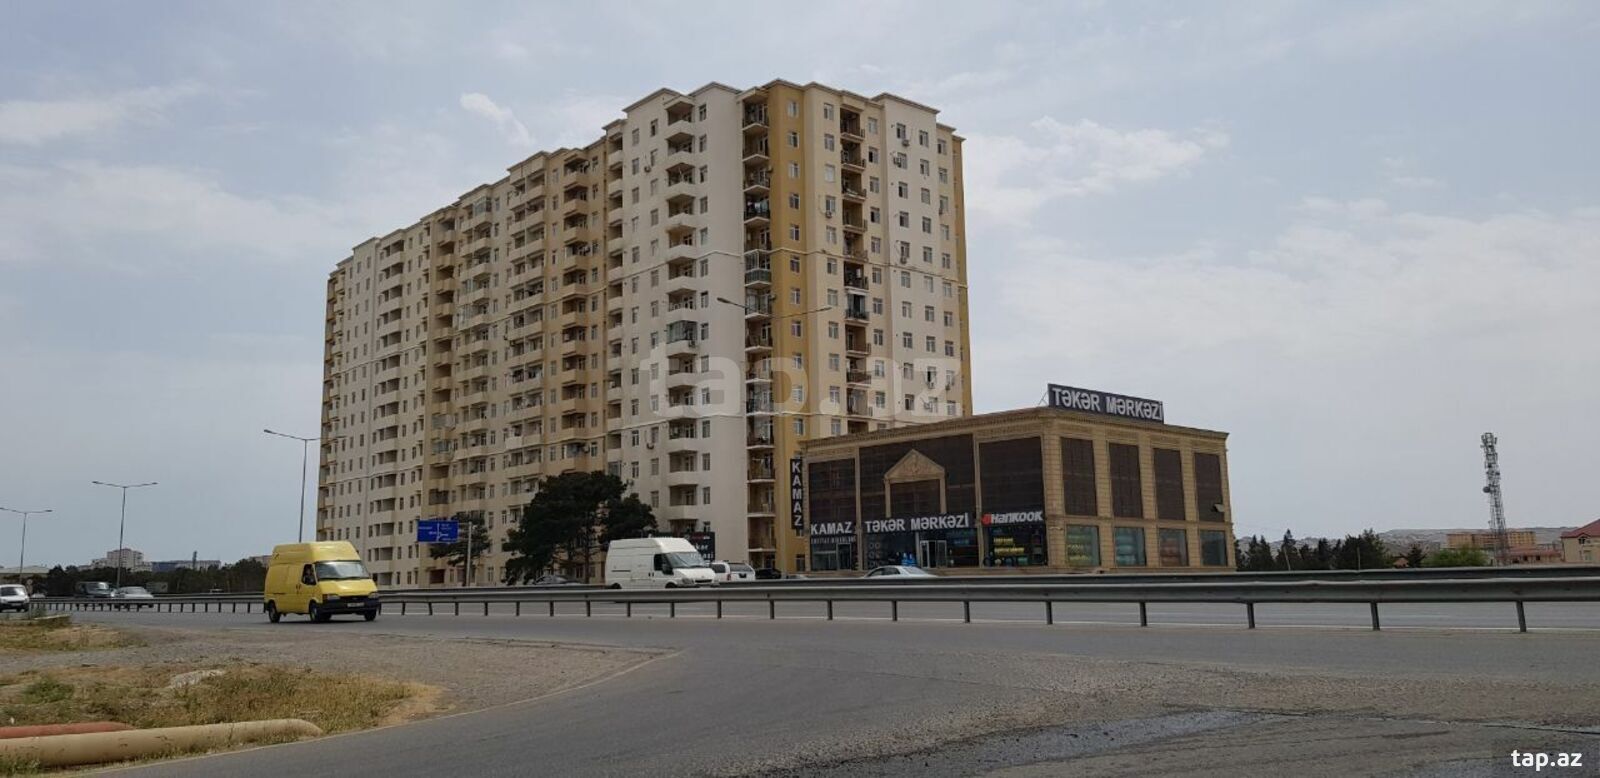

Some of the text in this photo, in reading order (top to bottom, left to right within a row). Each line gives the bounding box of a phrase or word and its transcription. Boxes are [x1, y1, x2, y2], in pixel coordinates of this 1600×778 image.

[1051, 387, 1101, 412] TƏKƏR
[791, 461, 802, 526] KAMAZ
[810, 521, 853, 535] KAMAZ
[864, 518, 906, 533] TƏKƏR
